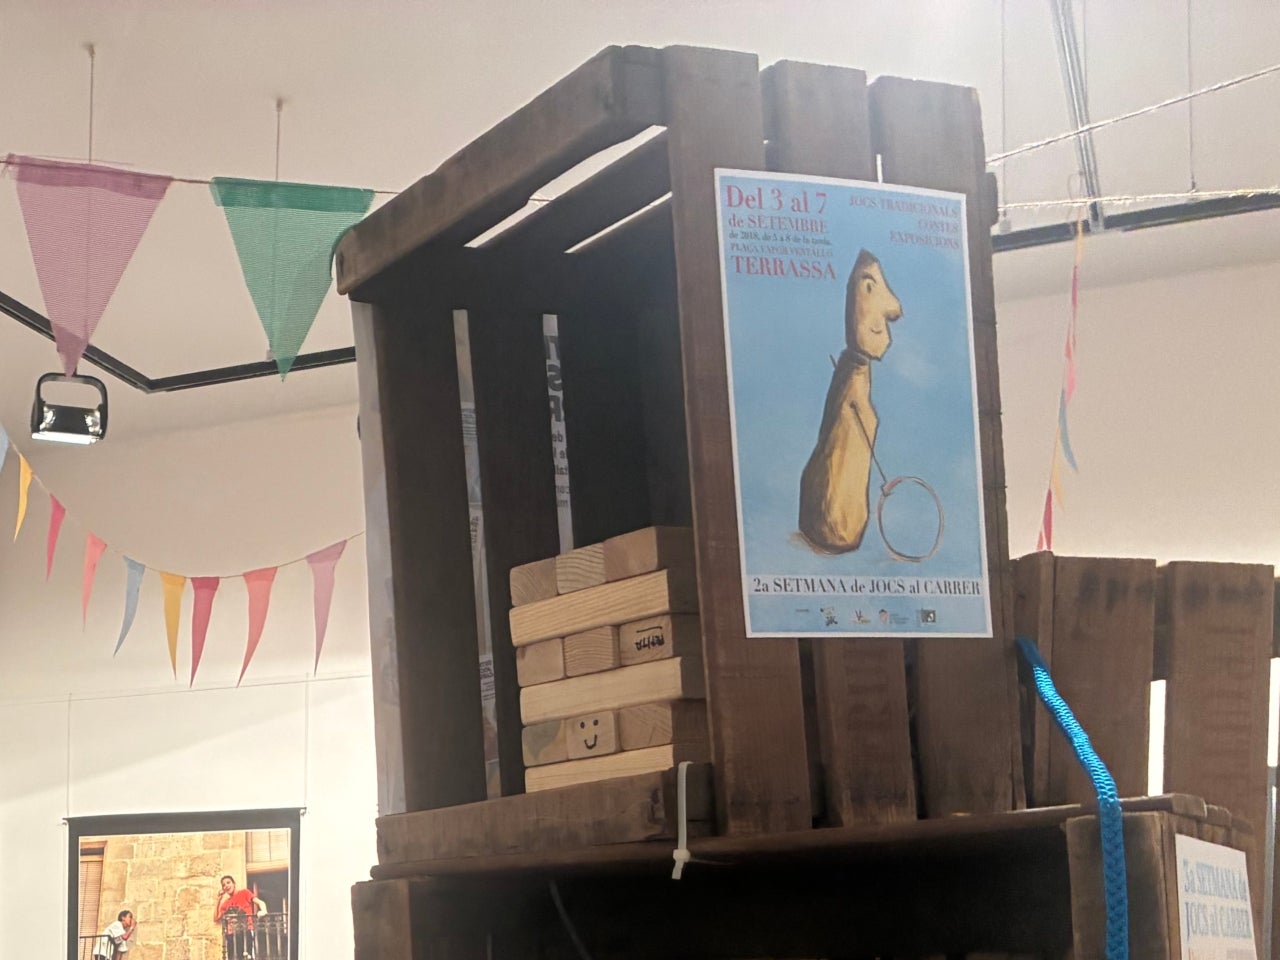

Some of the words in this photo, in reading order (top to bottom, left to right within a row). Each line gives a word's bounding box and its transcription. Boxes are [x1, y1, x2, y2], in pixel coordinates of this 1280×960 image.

[726, 185, 763, 210] Del
[771, 187, 783, 211] 3
[791, 191, 809, 214] al
[816, 192, 827, 214] 7
[728, 213, 743, 228] de
[747, 214, 828, 234] SETEMBRE
[730, 255, 837, 281] TERRASSA
[753, 577, 769, 594] 2a
[773, 577, 846, 594] SETMANA
[851, 578, 866, 594] de
[869, 579, 906, 595] JOCS
[909, 579, 920, 595] al
[924, 579, 981, 596] CARRER
